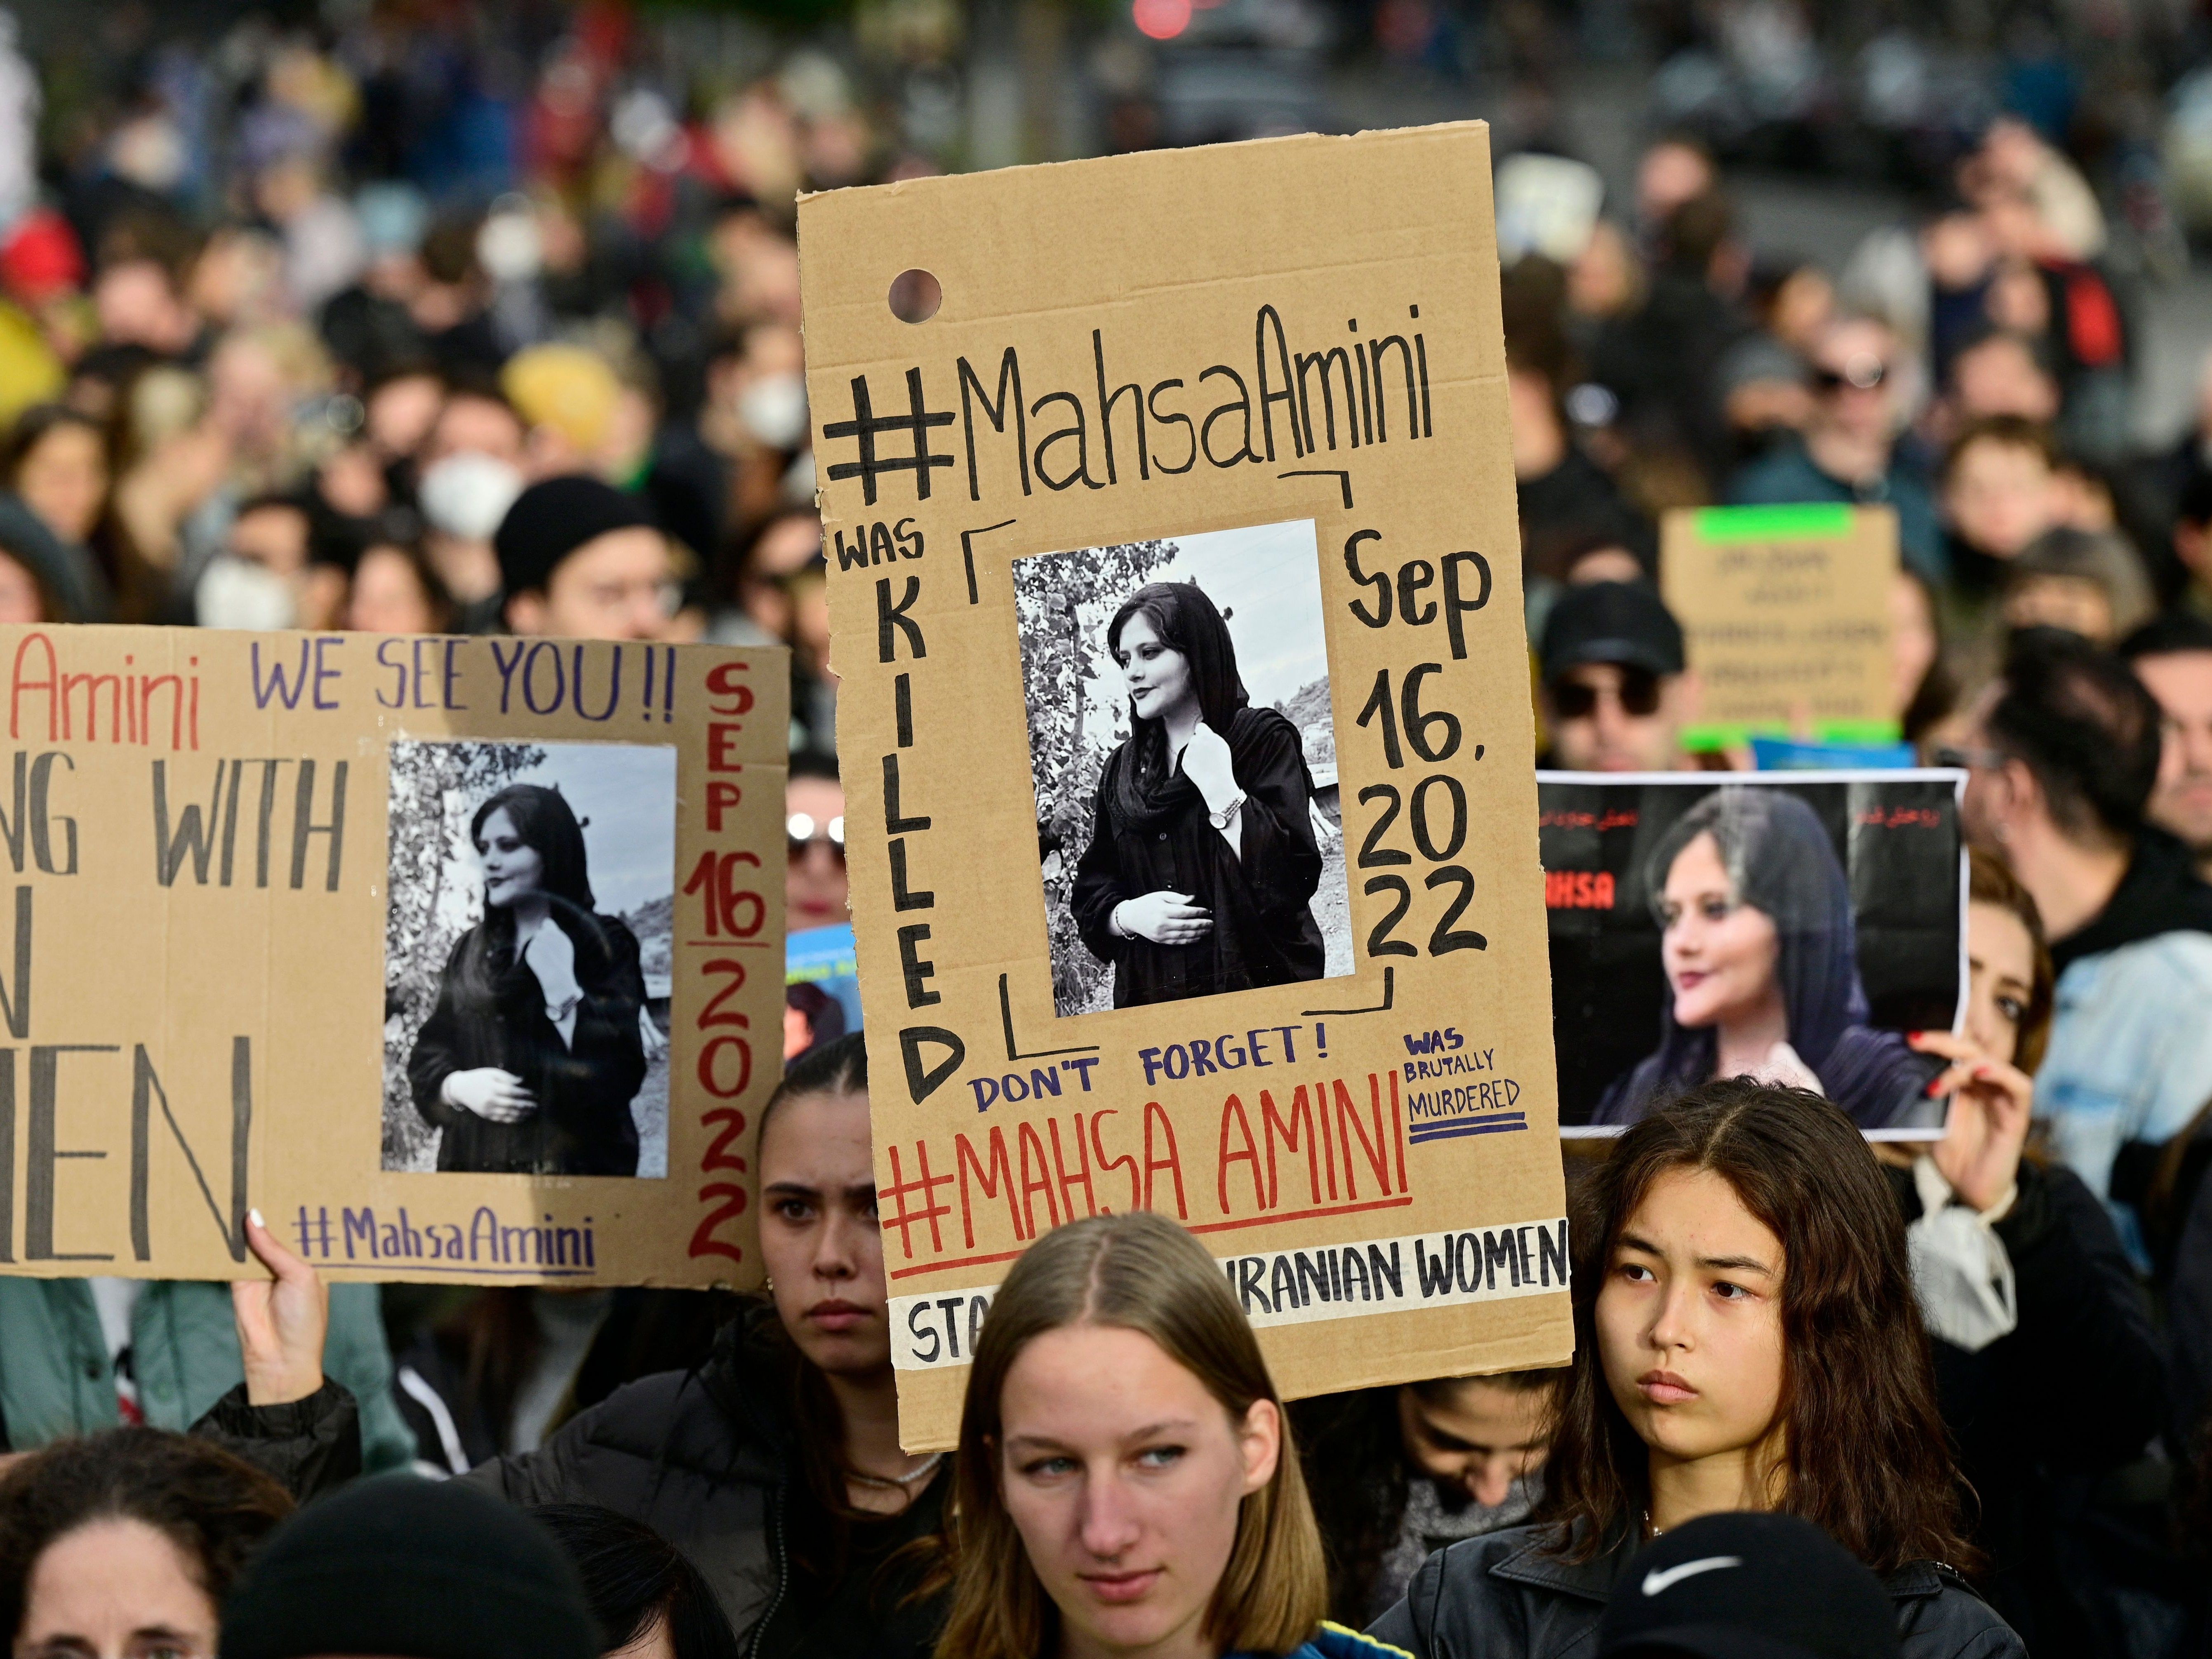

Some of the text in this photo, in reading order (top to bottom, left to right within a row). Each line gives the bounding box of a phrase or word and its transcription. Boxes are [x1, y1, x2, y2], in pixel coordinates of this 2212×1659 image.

[823, 304, 1433, 507] #MahsaAmini
[834, 517, 925, 572] WAS
[1344, 529, 1492, 660] Sep
[9, 632, 199, 751] Amini
[251, 637, 345, 710] WE
[376, 638, 471, 710] SEE
[152, 758, 348, 893] WITH
[1358, 774, 1468, 868] 20
[683, 850, 766, 939] 16
[1366, 864, 1488, 958] 22
[967, 1057, 1100, 1113] DON'T
[1403, 1027, 1464, 1056] WAS
[1403, 1048, 1494, 1084] BRUTALLY
[1407, 1078, 1520, 1122] MURDERED
[0, 1035, 252, 1264] EN
[878, 1070, 1408, 1259] #MAHSA AMINI
[291, 1205, 596, 1268] #MahsaAmini
[1226, 1240, 1404, 1315] IRANIAN
[1414, 1219, 1567, 1299] WOMEN
